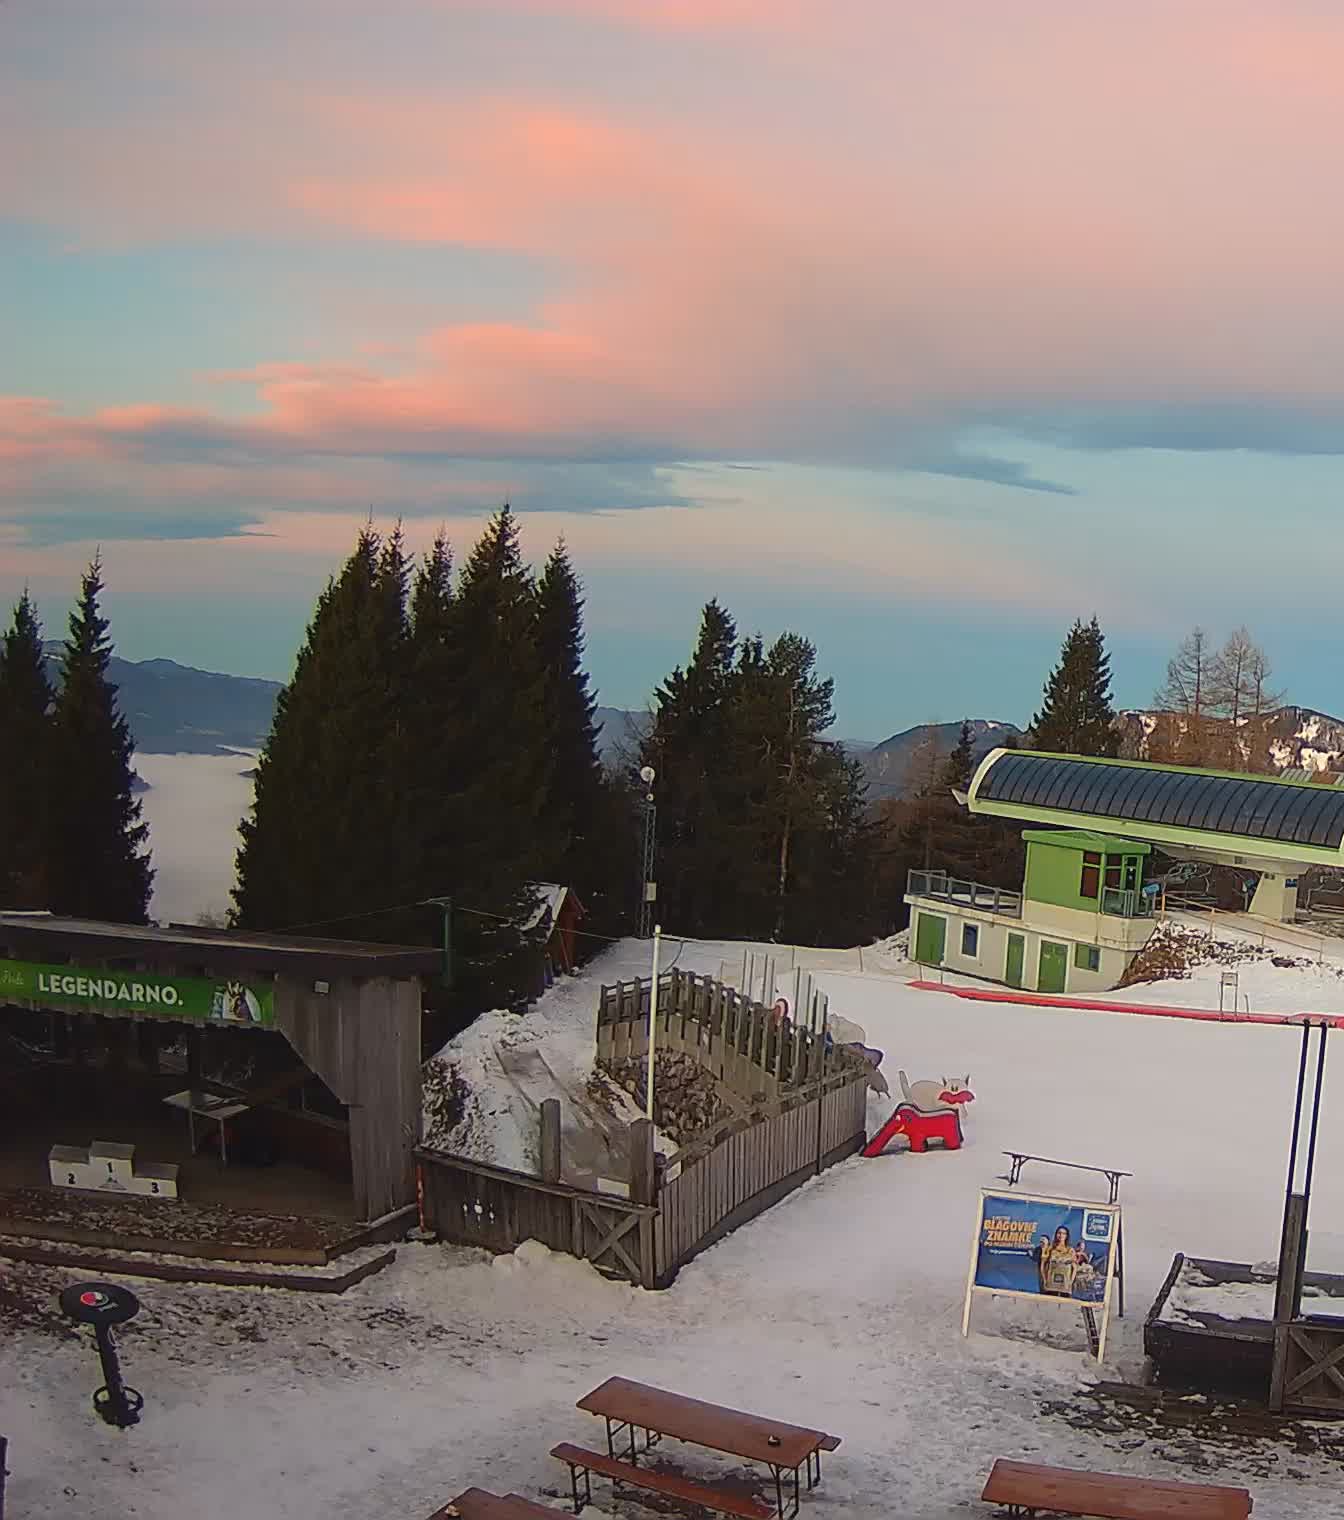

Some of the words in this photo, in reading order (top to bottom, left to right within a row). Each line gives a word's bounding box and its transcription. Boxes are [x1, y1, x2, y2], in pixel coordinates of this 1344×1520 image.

[38, 973, 184, 1006] LEGENDARNO.
[107, 1161, 113, 1174] 1
[67, 1172, 76, 1185] 2
[151, 1181, 160, 1194] 3
[986, 1230, 1033, 1243] ZNAMKE
